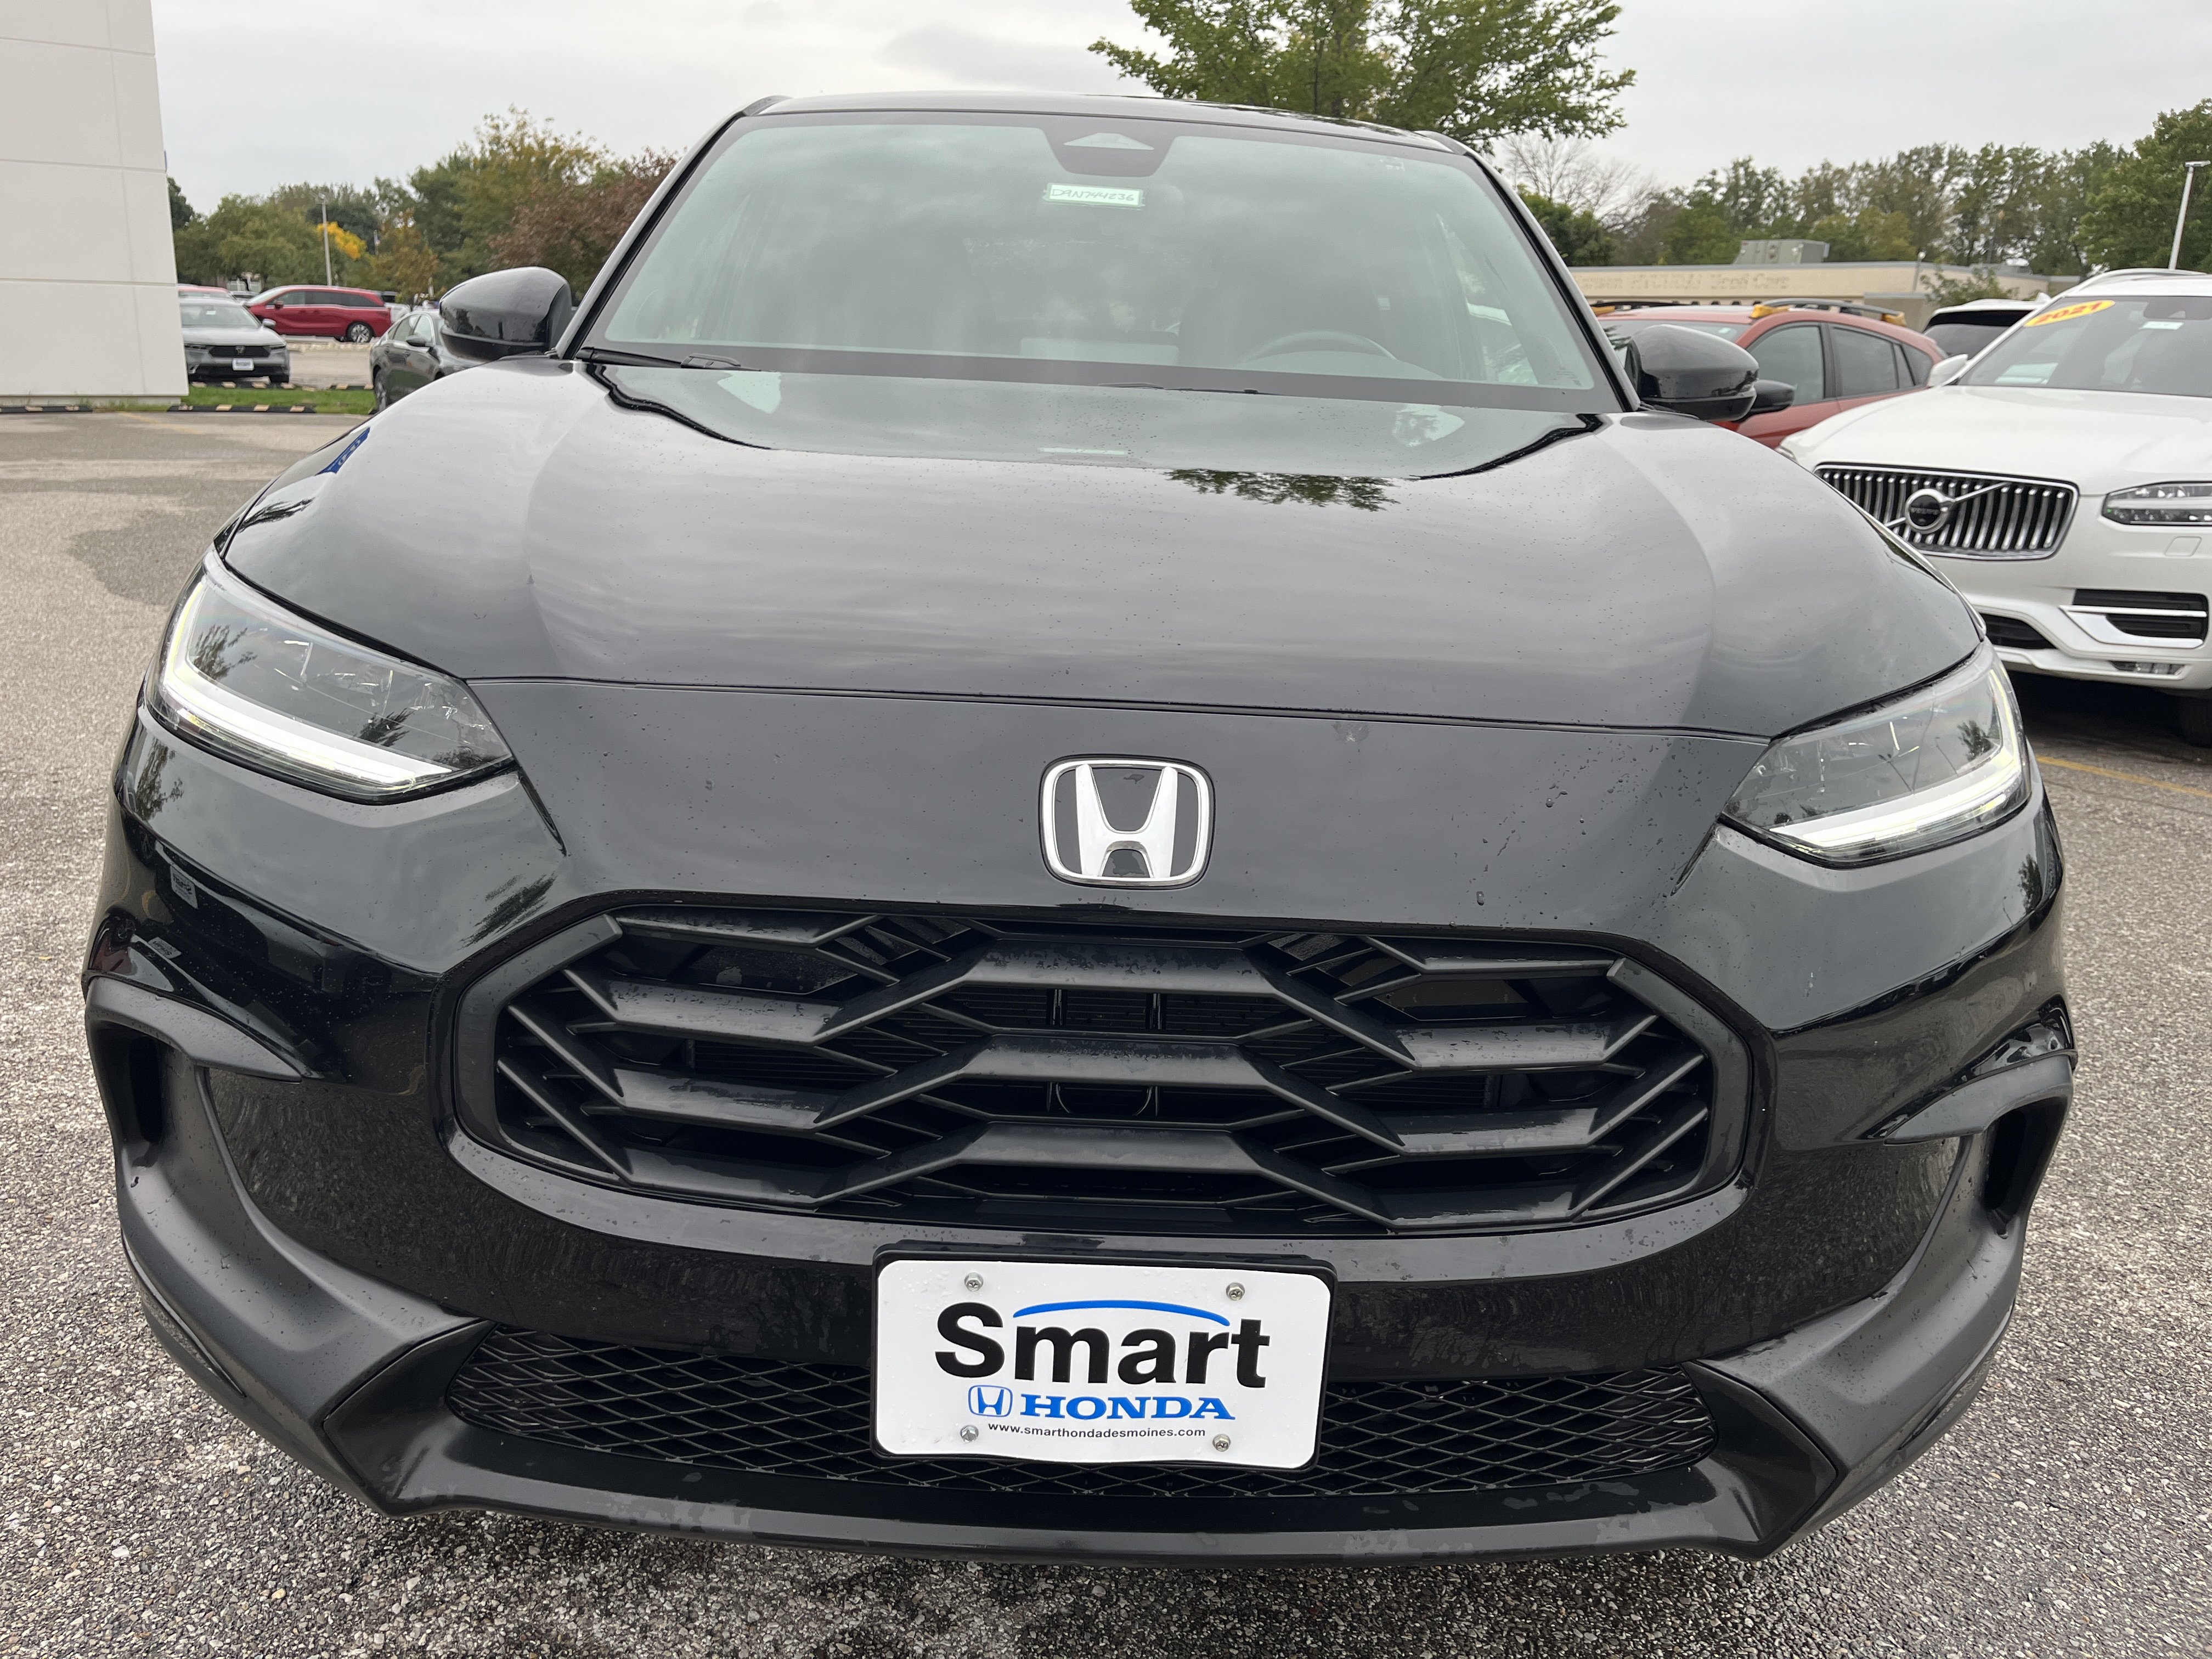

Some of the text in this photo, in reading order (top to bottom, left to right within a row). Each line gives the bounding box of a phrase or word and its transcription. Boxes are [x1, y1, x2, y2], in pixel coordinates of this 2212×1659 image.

[2034, 302, 2102, 323] 2021
[935, 1302, 1271, 1388] Smart
[1020, 1393, 1235, 1420] HONDA
[988, 1423, 1206, 1438] www.smarthondadesmoines.com
